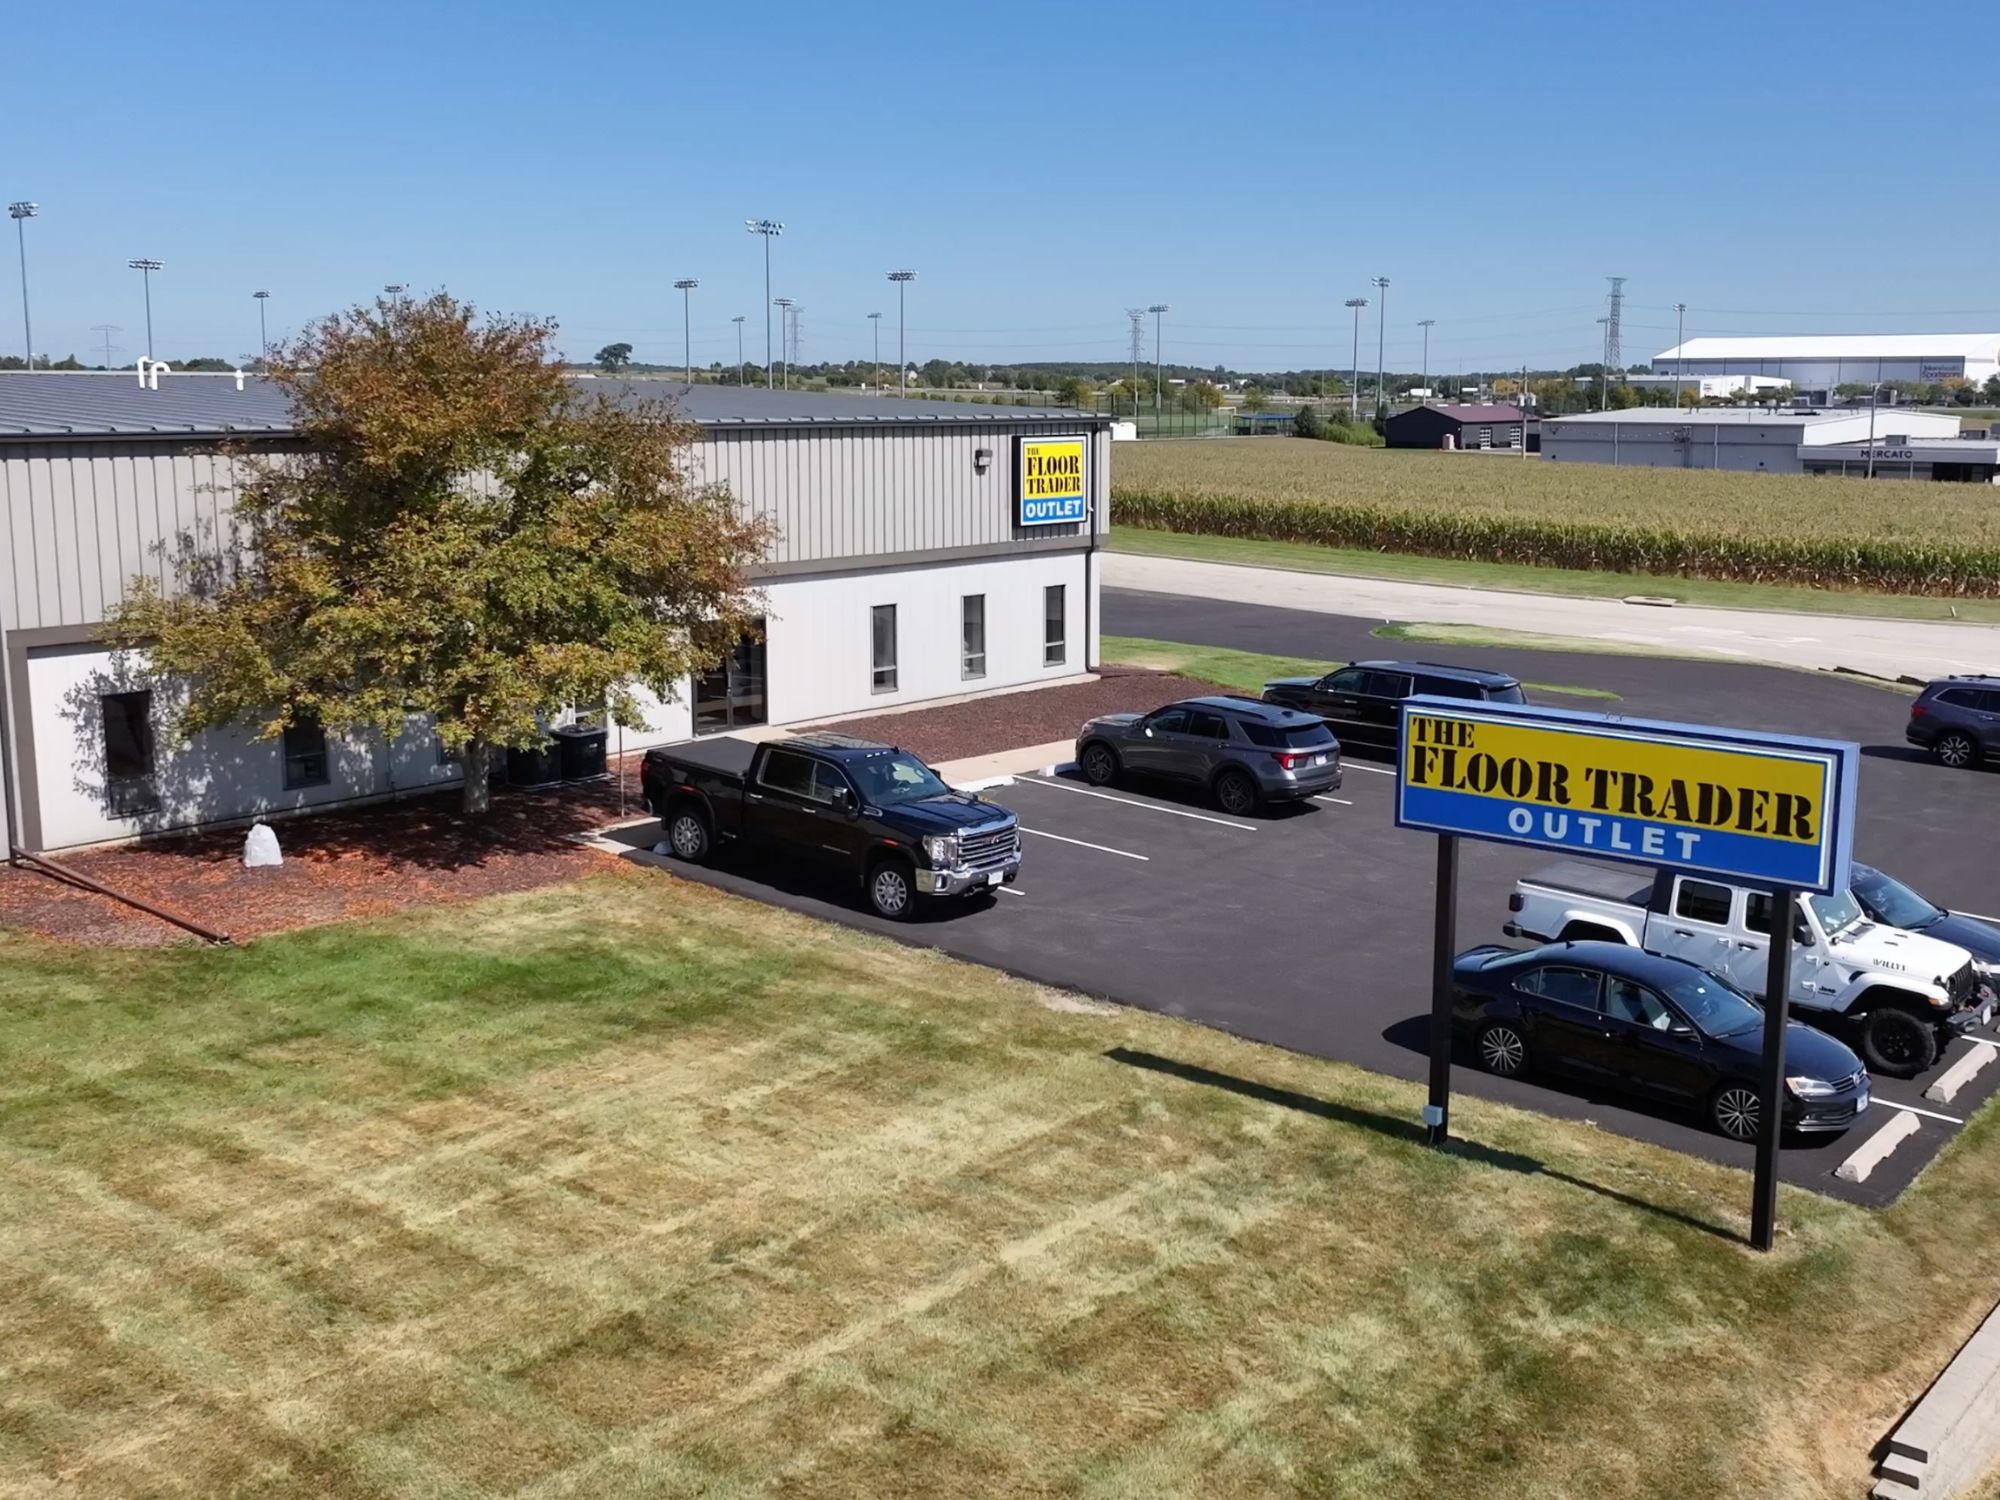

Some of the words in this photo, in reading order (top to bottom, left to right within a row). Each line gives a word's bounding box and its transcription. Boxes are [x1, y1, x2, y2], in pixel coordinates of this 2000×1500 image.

[1860, 450, 1913, 459] MERCATO
[1026, 455, 1080, 477] FLOOR
[1026, 476, 1081, 494] TRADER
[1026, 500, 1081, 518] OUTLET
[1412, 717, 1475, 749] THE
[1411, 745, 1571, 805] FLOOR
[1585, 767, 1815, 840] TRADER
[1508, 807, 1701, 860] OUTLET
